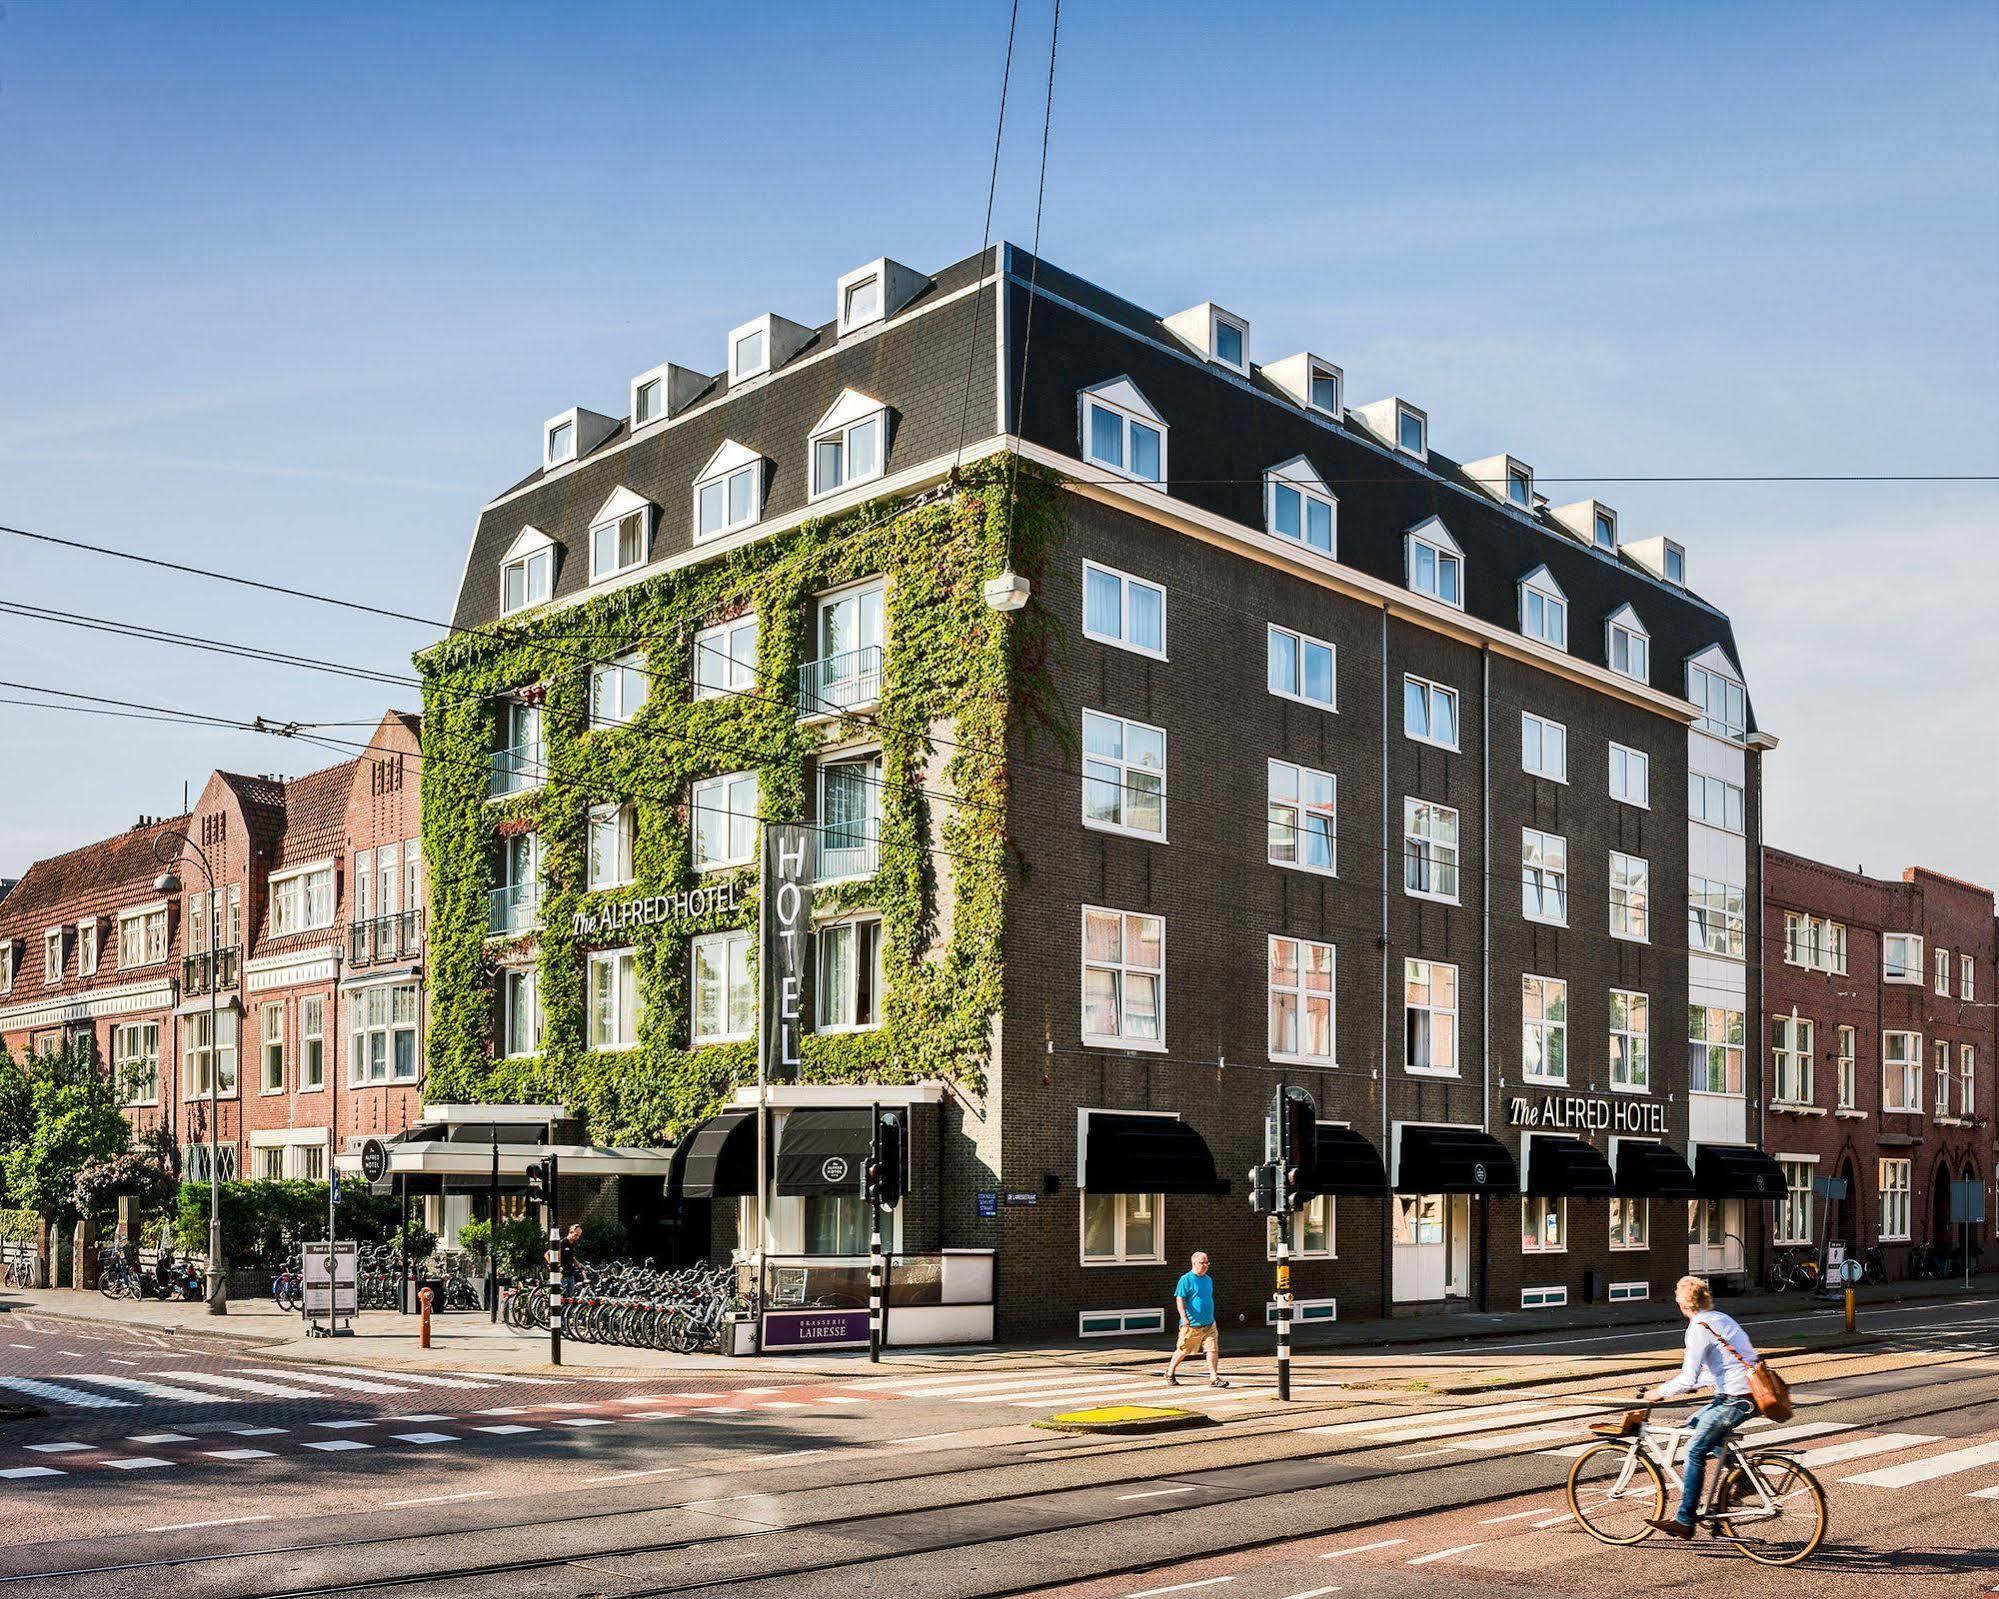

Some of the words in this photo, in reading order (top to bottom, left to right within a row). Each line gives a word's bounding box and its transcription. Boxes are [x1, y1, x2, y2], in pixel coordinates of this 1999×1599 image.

[572, 911, 597, 936] The
[600, 896, 670, 931] ALFRED
[674, 884, 740, 920] HOTEL
[776, 836, 805, 1065] HOTEL
[1510, 1097, 1538, 1126] The
[1542, 1096, 1610, 1130] ALFRED
[1615, 1101, 1669, 1133] HOTEL
[800, 1318, 847, 1327] BRASSERIE
[800, 1326, 847, 1339] LAIRESSE
